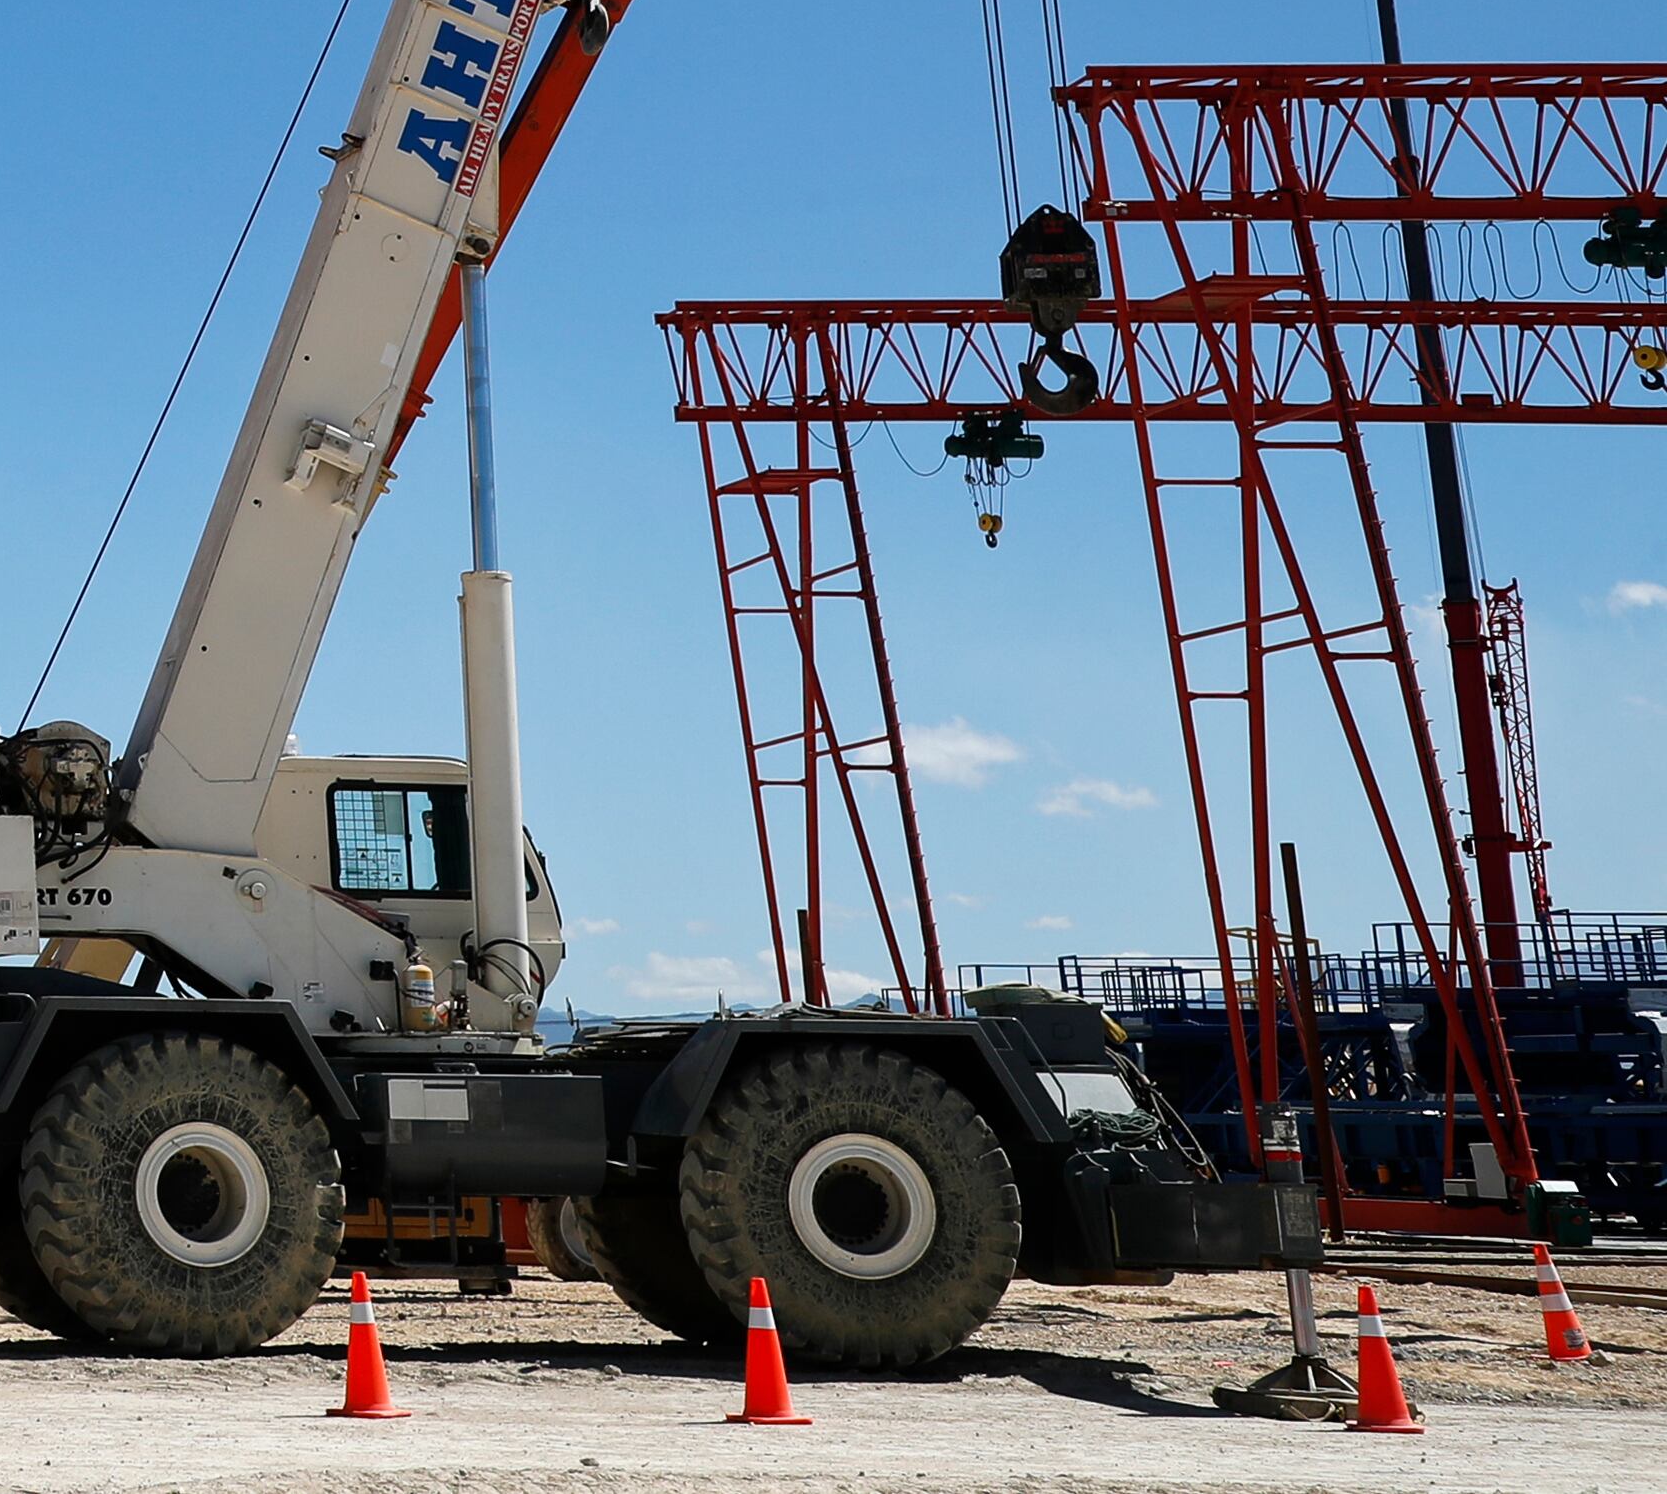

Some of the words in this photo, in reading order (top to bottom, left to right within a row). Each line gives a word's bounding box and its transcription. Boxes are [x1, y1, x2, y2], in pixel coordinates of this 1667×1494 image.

[457, 155, 479, 198] ALL
[470, 96, 501, 161] HEAVY
[67, 888, 112, 906] 670
